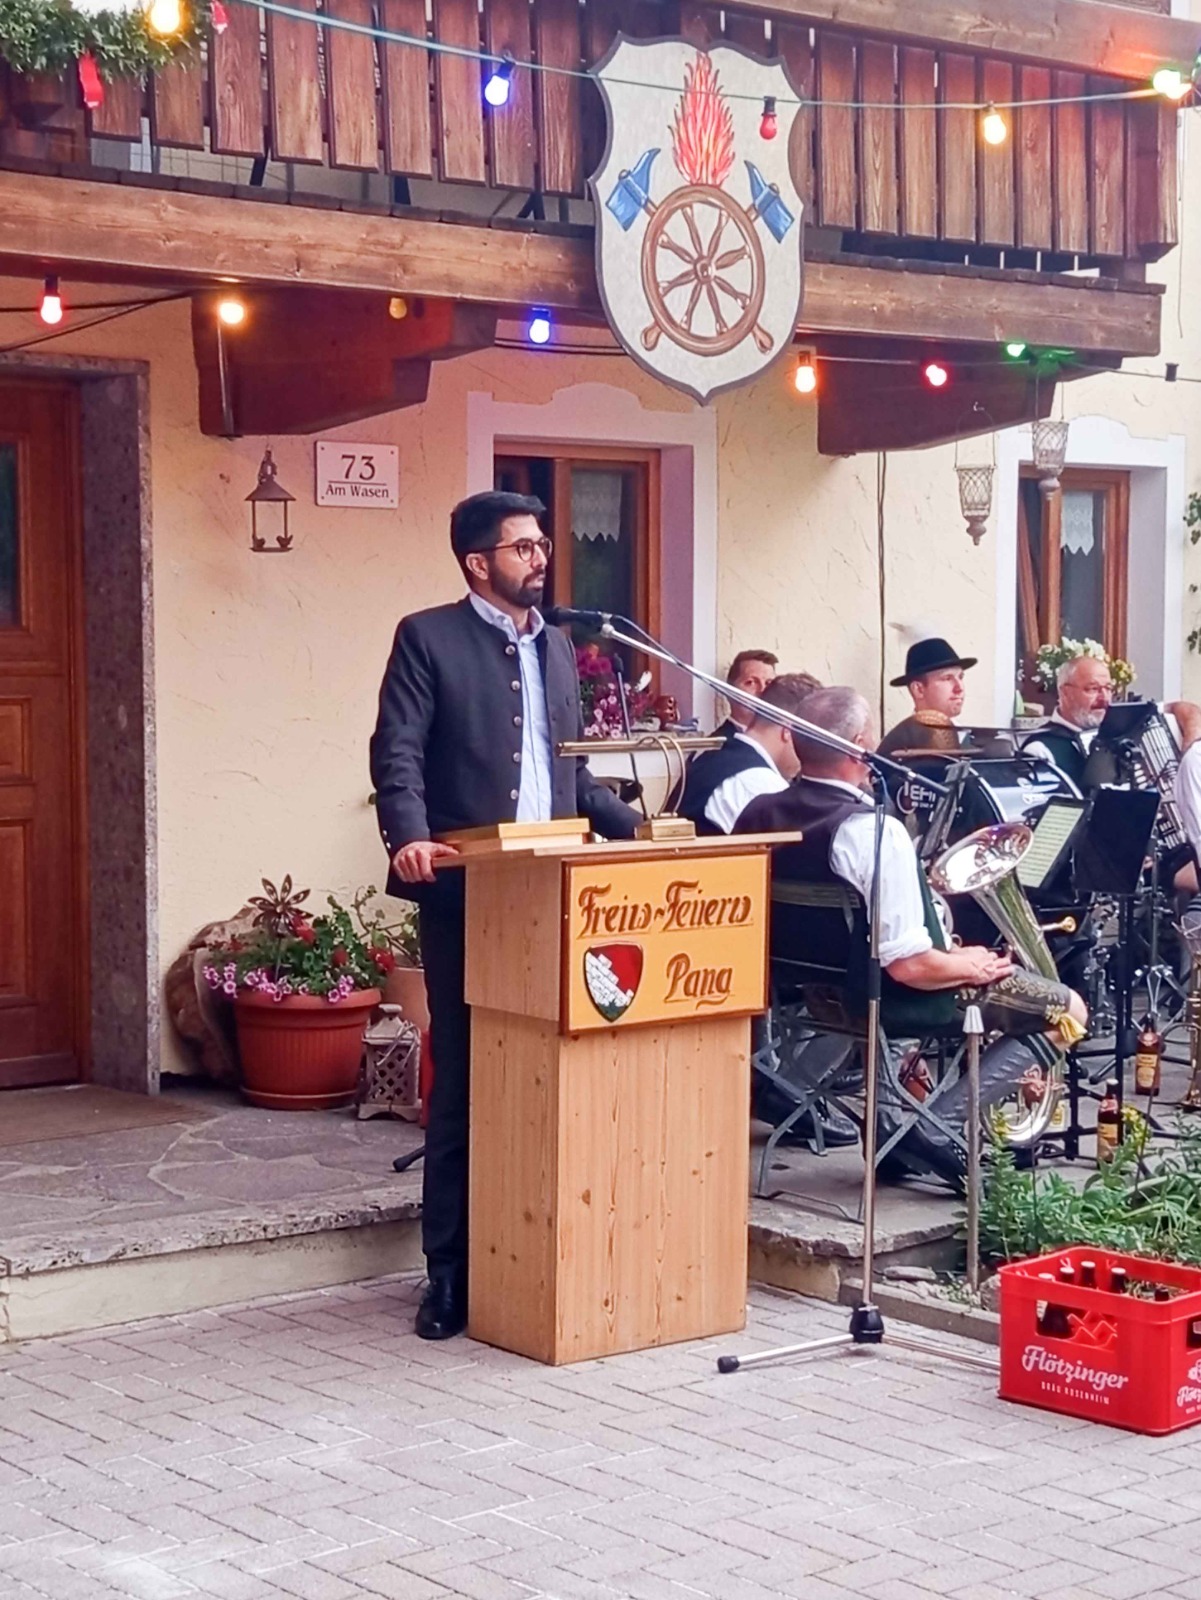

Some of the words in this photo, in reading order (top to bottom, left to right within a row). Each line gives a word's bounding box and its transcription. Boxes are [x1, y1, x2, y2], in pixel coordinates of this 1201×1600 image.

[341, 454, 376, 481] 73
[325, 484, 346, 497] Am
[350, 485, 389, 498] Wasen
[663, 952, 734, 1011] Pang
[1021, 1345, 1129, 1391] Flötzinger
